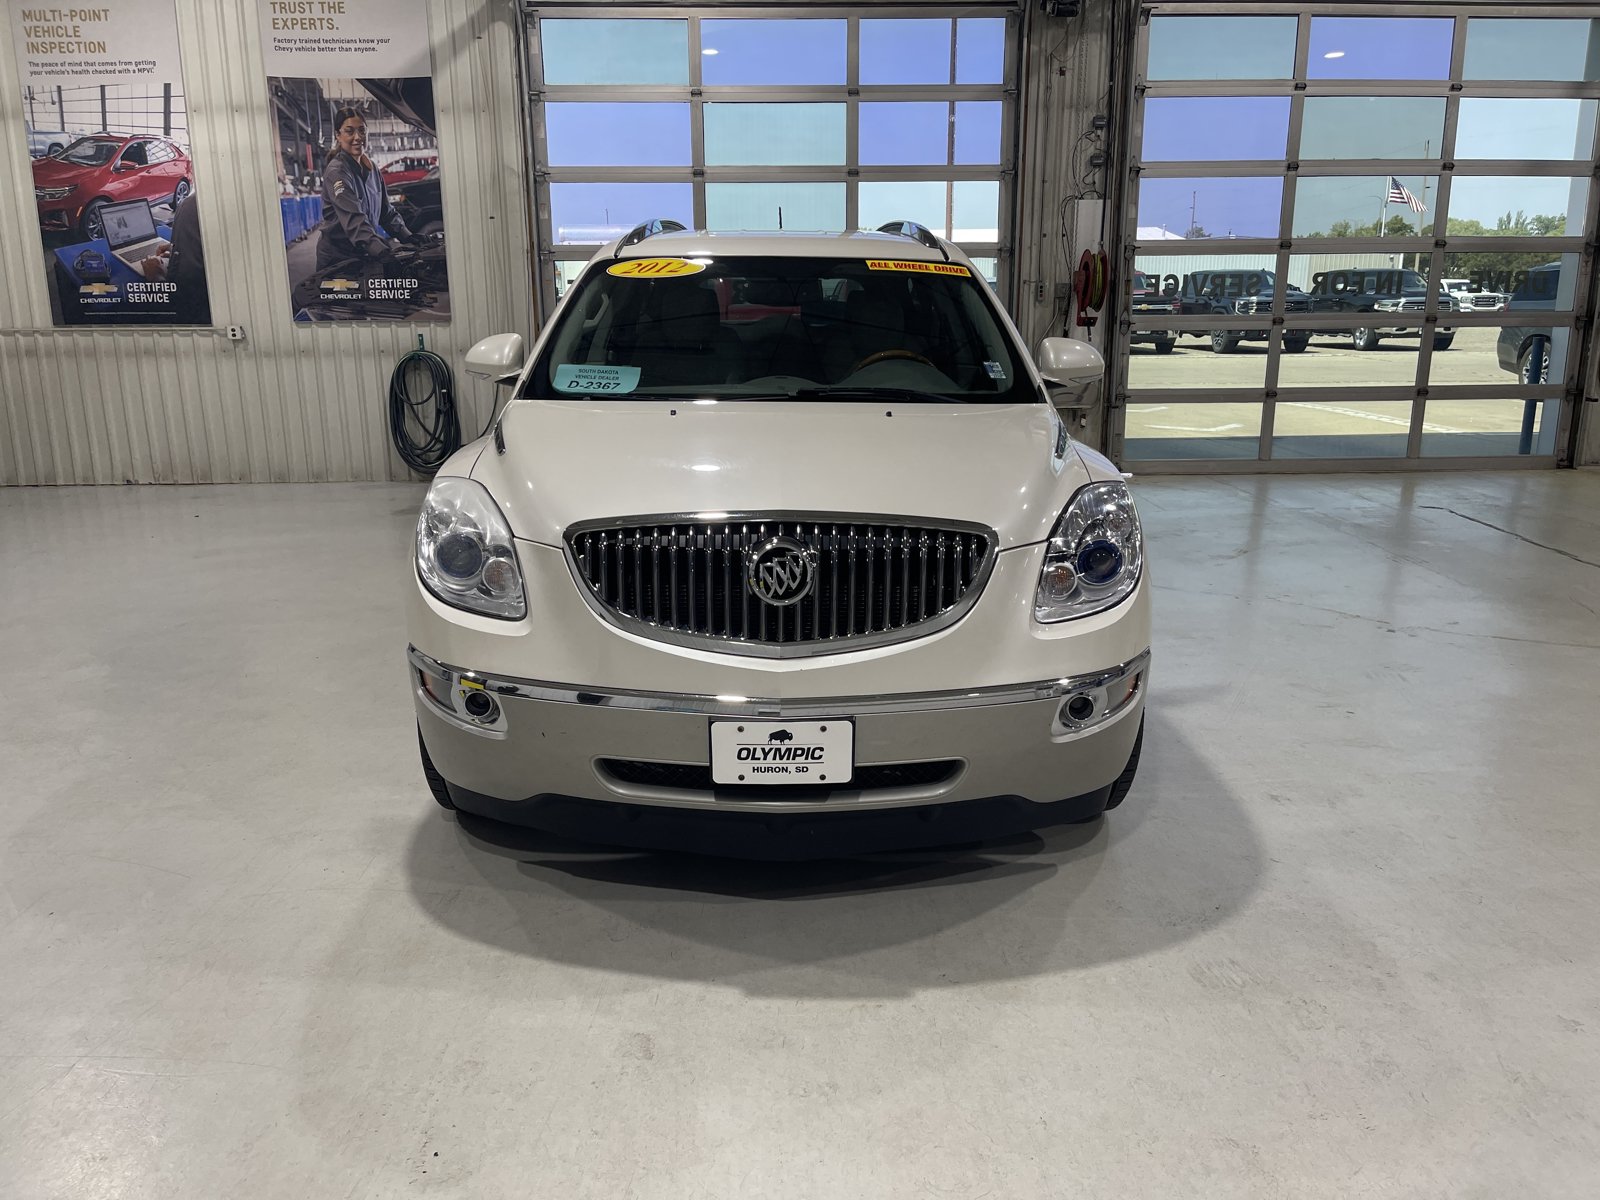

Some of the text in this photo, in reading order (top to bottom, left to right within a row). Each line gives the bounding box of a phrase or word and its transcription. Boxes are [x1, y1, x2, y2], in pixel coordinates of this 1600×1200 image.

[270, 1, 346, 14] TRUST THE
[22, 9, 110, 22] MULTI-POINT
[272, 17, 339, 31] EXPERTS.
[24, 25, 81, 38] VEHICLE
[273, 37, 297, 45] Factory
[26, 41, 107, 54] INSPECTION
[274, 45, 293, 53] Chevy
[620, 262, 689, 274] 2012
[893, 262, 932, 271] WHEEL
[933, 265, 967, 274] DRIVE
[127, 282, 177, 292] CERTIFIED
[367, 279, 418, 288] CERTIFIED
[128, 293, 169, 302] SERVICE
[369, 290, 411, 299] SERVICE
[567, 380, 621, 390] D-2367
[736, 746, 825, 761] OLYMPIC
[752, 766, 792, 775] HURON,
